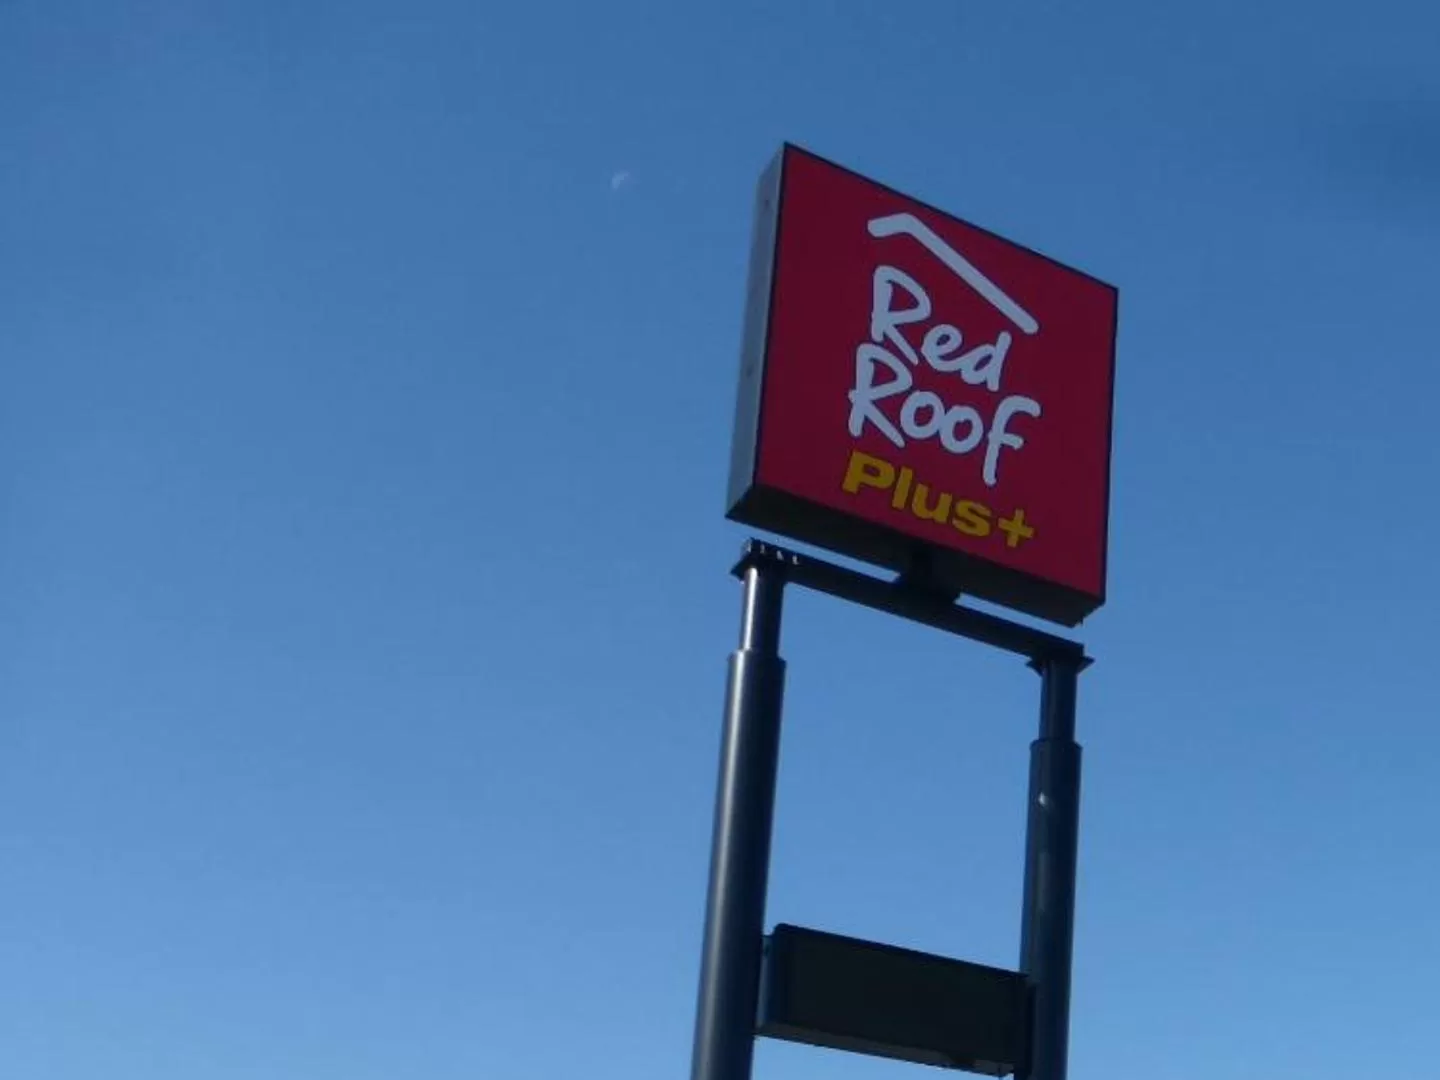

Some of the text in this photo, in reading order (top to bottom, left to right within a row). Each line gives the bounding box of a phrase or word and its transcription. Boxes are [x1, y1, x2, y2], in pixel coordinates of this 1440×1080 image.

[871, 264, 1011, 391] Red
[848, 342, 1040, 486] Roof
[841, 451, 1036, 549] Plus+
